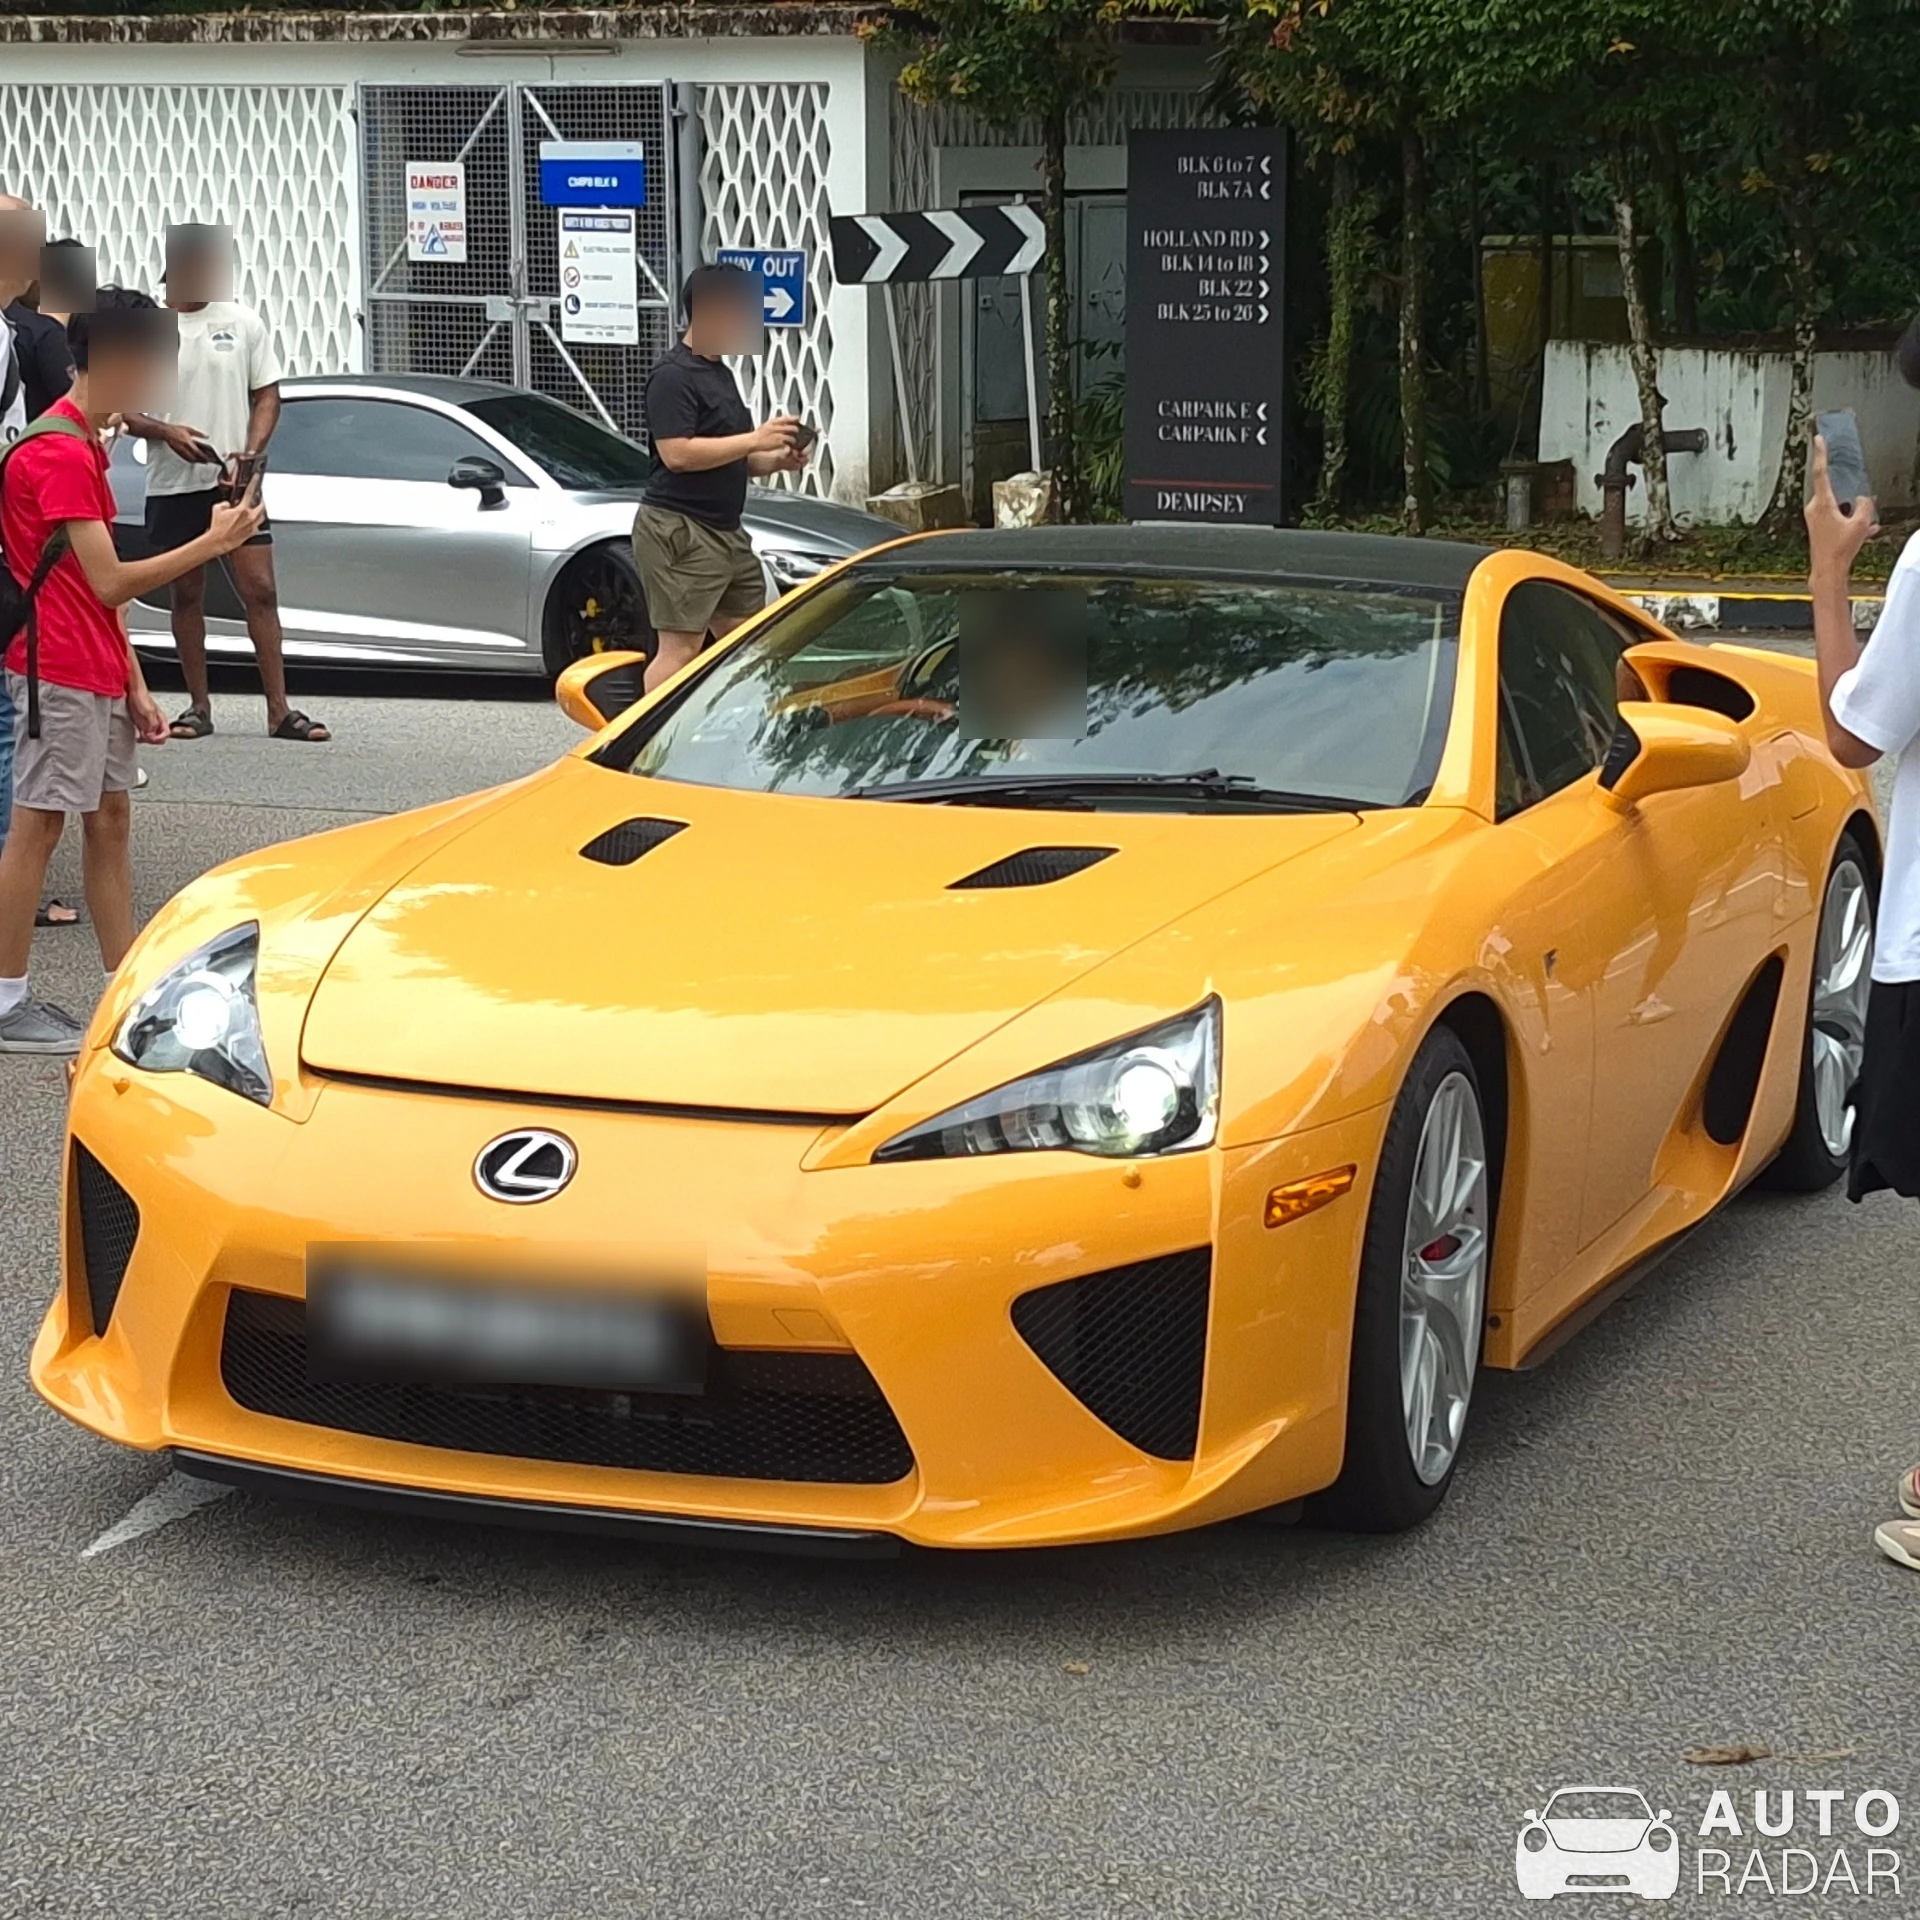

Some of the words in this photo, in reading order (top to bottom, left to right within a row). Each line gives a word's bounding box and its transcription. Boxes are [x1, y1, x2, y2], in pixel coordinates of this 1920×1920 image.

[1178, 156, 1210, 174] BLK
[1213, 156, 1223, 173] 6
[1226, 158, 1242, 173] to
[1246, 156, 1255, 174] 7
[410, 175, 458, 190] DANGER
[1197, 181, 1230, 198] BLK
[1233, 181, 1253, 198] 7A
[1143, 229, 1226, 247] HOLLAND
[1230, 230, 1254, 247] RD
[763, 256, 800, 277] OUT
[1161, 254, 1194, 272] BLK
[1198, 254, 1213, 272] 14
[1217, 256, 1233, 272] to
[1238, 255, 1254, 272] 18
[1199, 279, 1231, 297] BLK
[1234, 280, 1253, 297] 22
[1158, 303, 1190, 321] BLK
[1192, 303, 1211, 321] 25
[1214, 305, 1231, 321] to
[1233, 304, 1253, 321] 26
[1158, 400, 1237, 419] CARPARK
[1240, 402, 1251, 419] E
[1158, 425, 1237, 442] CARPARK
[1240, 427, 1251, 443] F
[1157, 491, 1248, 513] DEMPSEY
